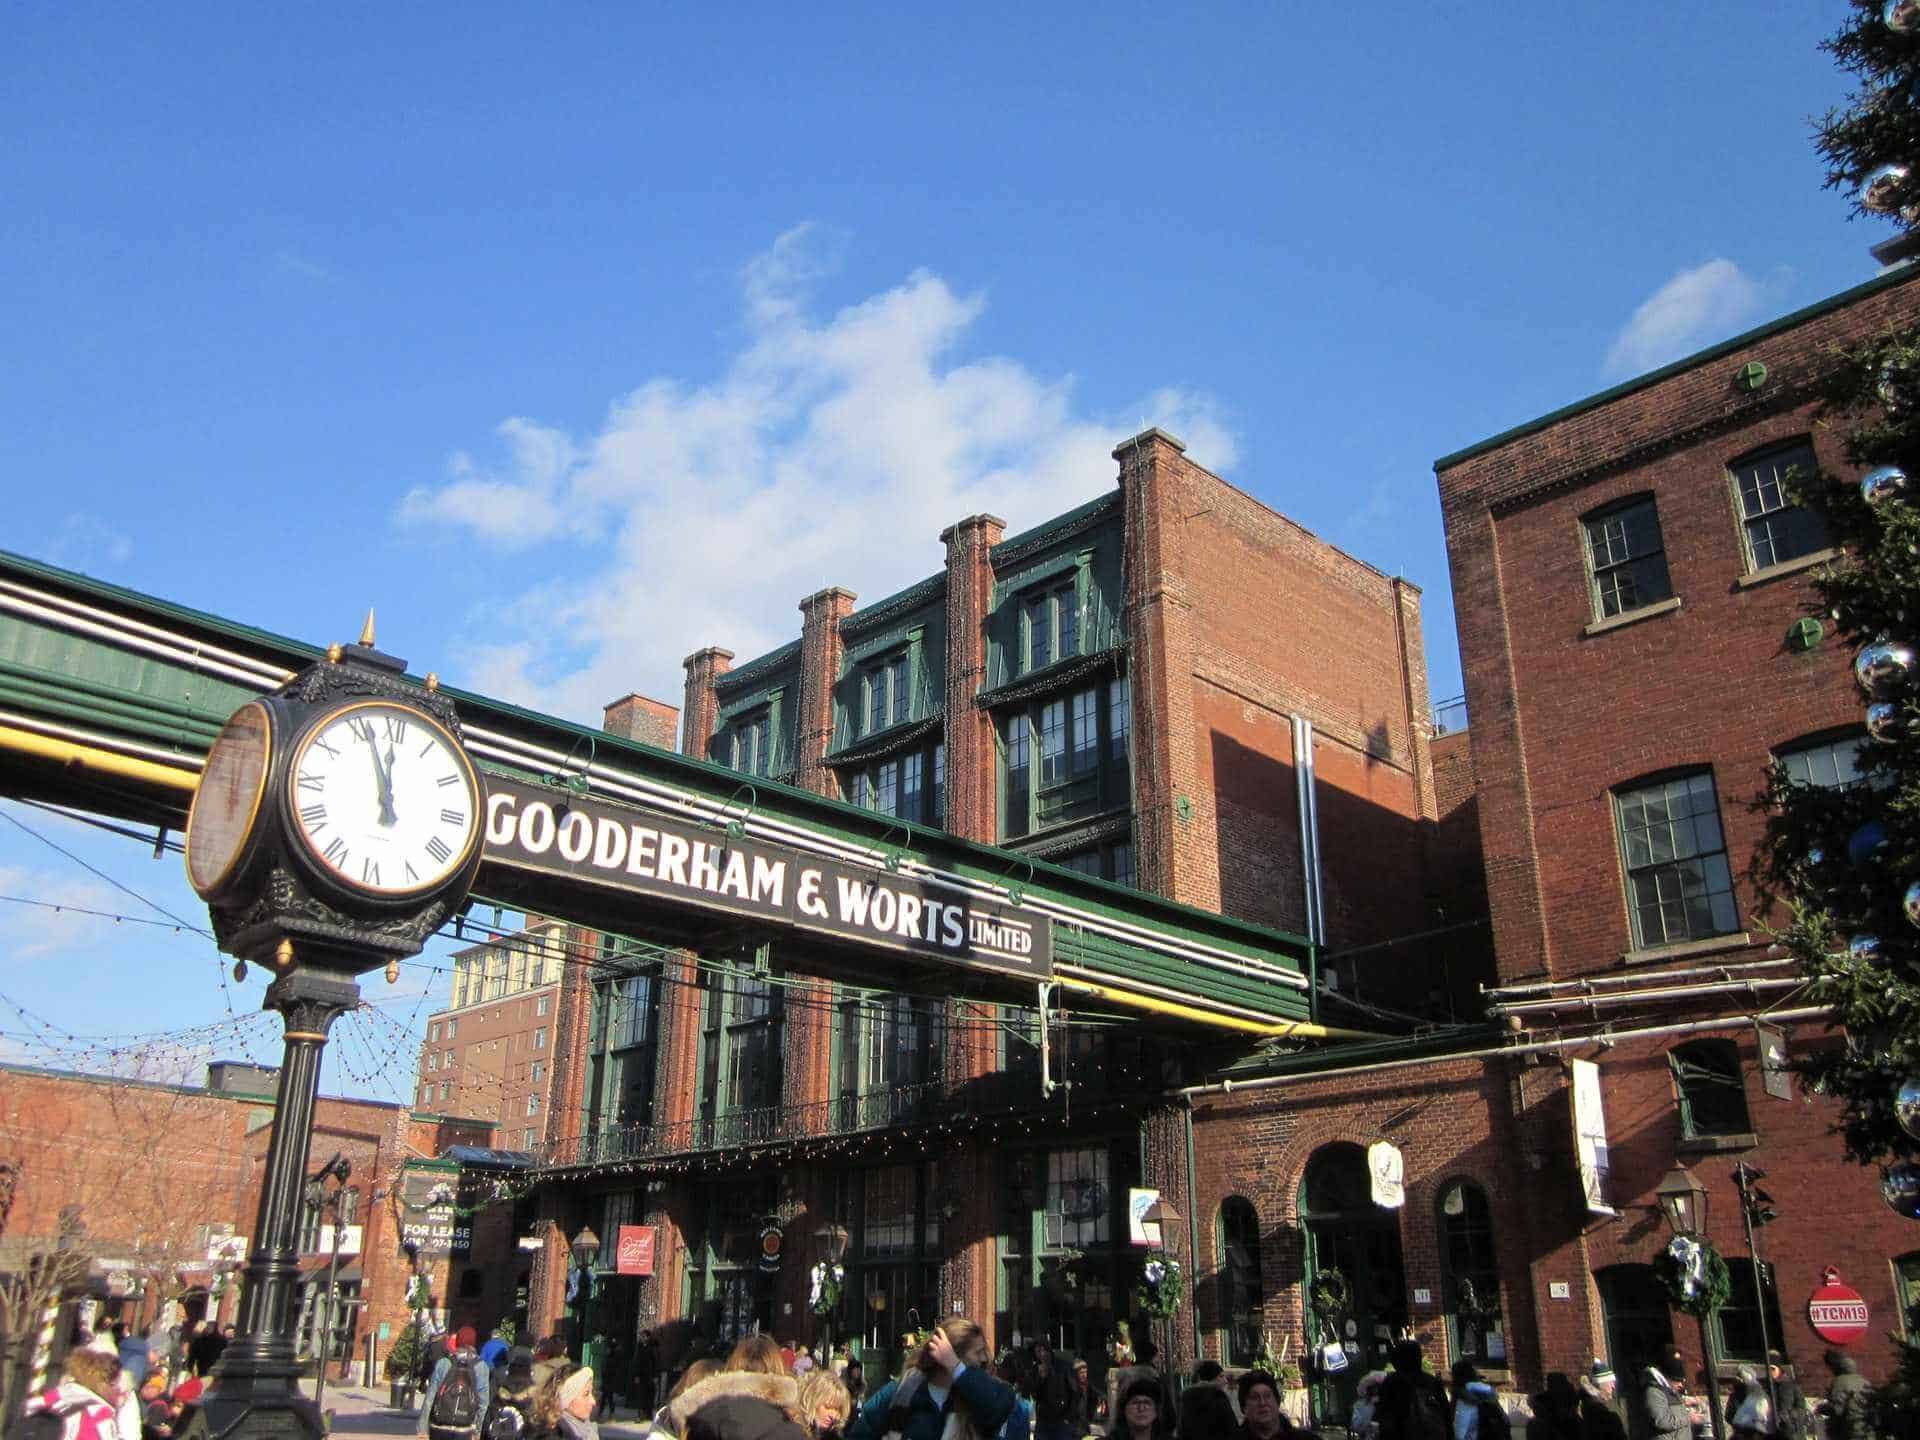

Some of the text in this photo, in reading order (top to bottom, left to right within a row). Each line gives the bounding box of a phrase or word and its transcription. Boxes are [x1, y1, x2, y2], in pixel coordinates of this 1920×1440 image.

[485, 793, 1032, 953] GOODERHAM & WORTS LIMITED
[404, 1223, 471, 1239] FOR LEASE
[1811, 1306, 1867, 1321] #TCM19
